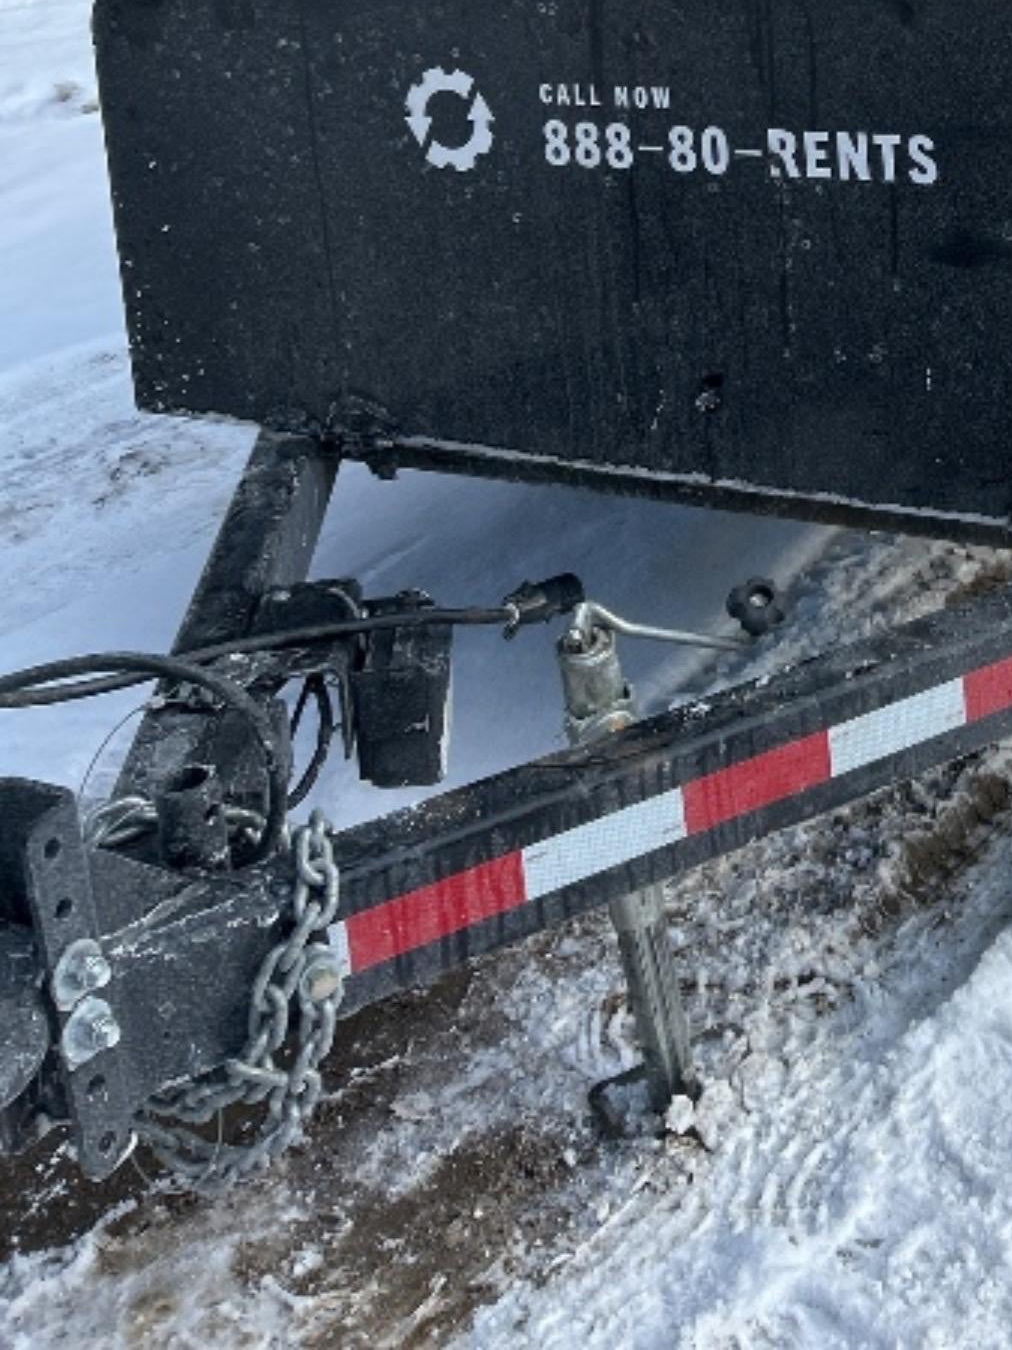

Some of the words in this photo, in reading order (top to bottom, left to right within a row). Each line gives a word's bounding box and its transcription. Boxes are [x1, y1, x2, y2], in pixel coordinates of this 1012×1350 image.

[539, 83, 600, 107] CALL
[615, 87, 671, 108] NOW
[543, 120, 938, 184] 888-80-RENTS
